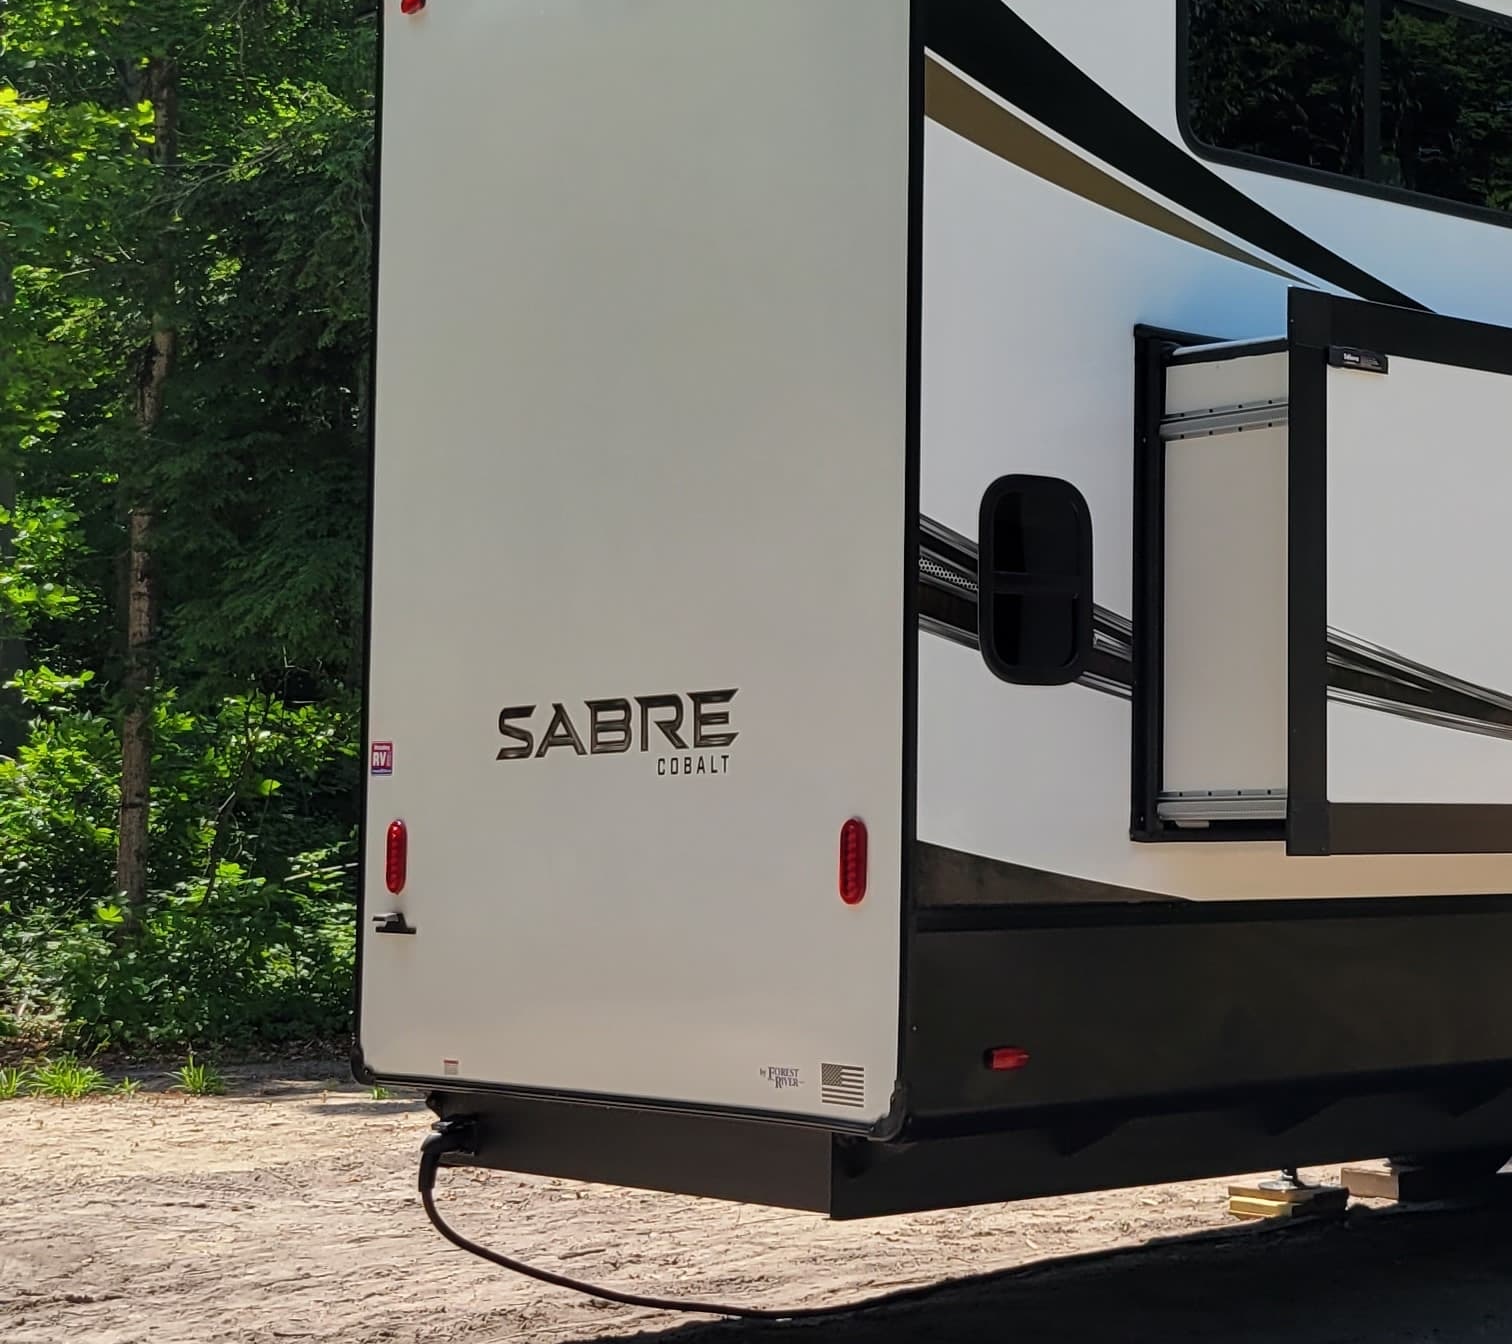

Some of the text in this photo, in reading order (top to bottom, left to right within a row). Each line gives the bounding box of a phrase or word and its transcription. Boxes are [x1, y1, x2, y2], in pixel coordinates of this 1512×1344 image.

[496, 688, 739, 760] SABRE
[372, 751, 387, 767] RV
[657, 755, 730, 776] COBALT
[768, 1066, 800, 1081] FOREST
[775, 1076, 799, 1089] RIVER
